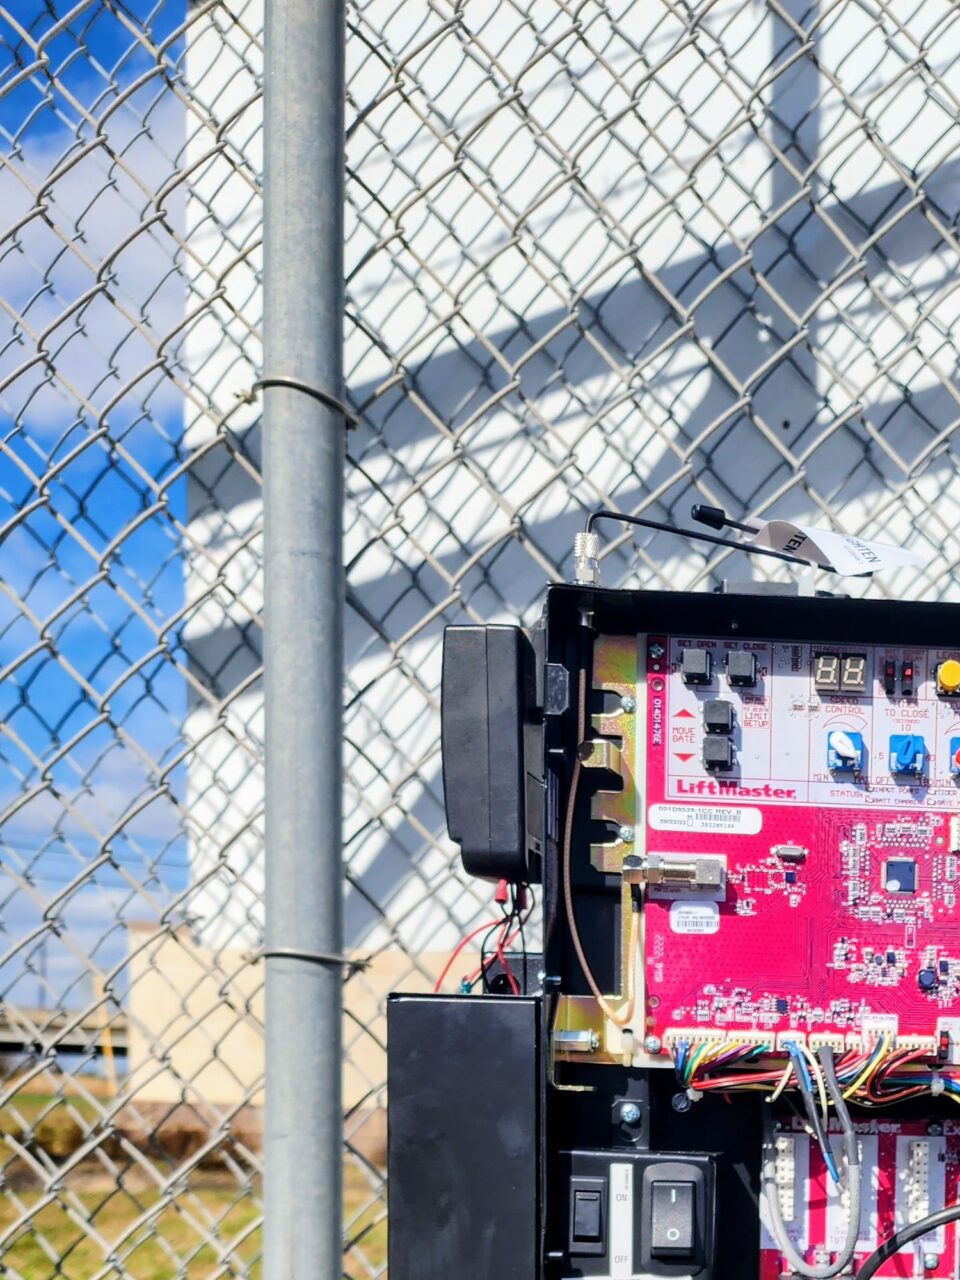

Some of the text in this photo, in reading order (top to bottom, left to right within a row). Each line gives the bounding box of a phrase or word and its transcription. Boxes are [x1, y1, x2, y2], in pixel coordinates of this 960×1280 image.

[825, 705, 865, 715] CONTROL
[885, 708, 930, 719] TO CLOSE
[743, 719, 769, 728] SETUP
[673, 727, 696, 736] MOVE
[673, 735, 696, 744] GATE
[813, 773, 829, 782] MIN
[875, 776, 891, 785] OFF
[676, 778, 797, 799] LiftMaster
[615, 1193, 628, 1202] ON
[614, 1255, 629, 1264] OFF
